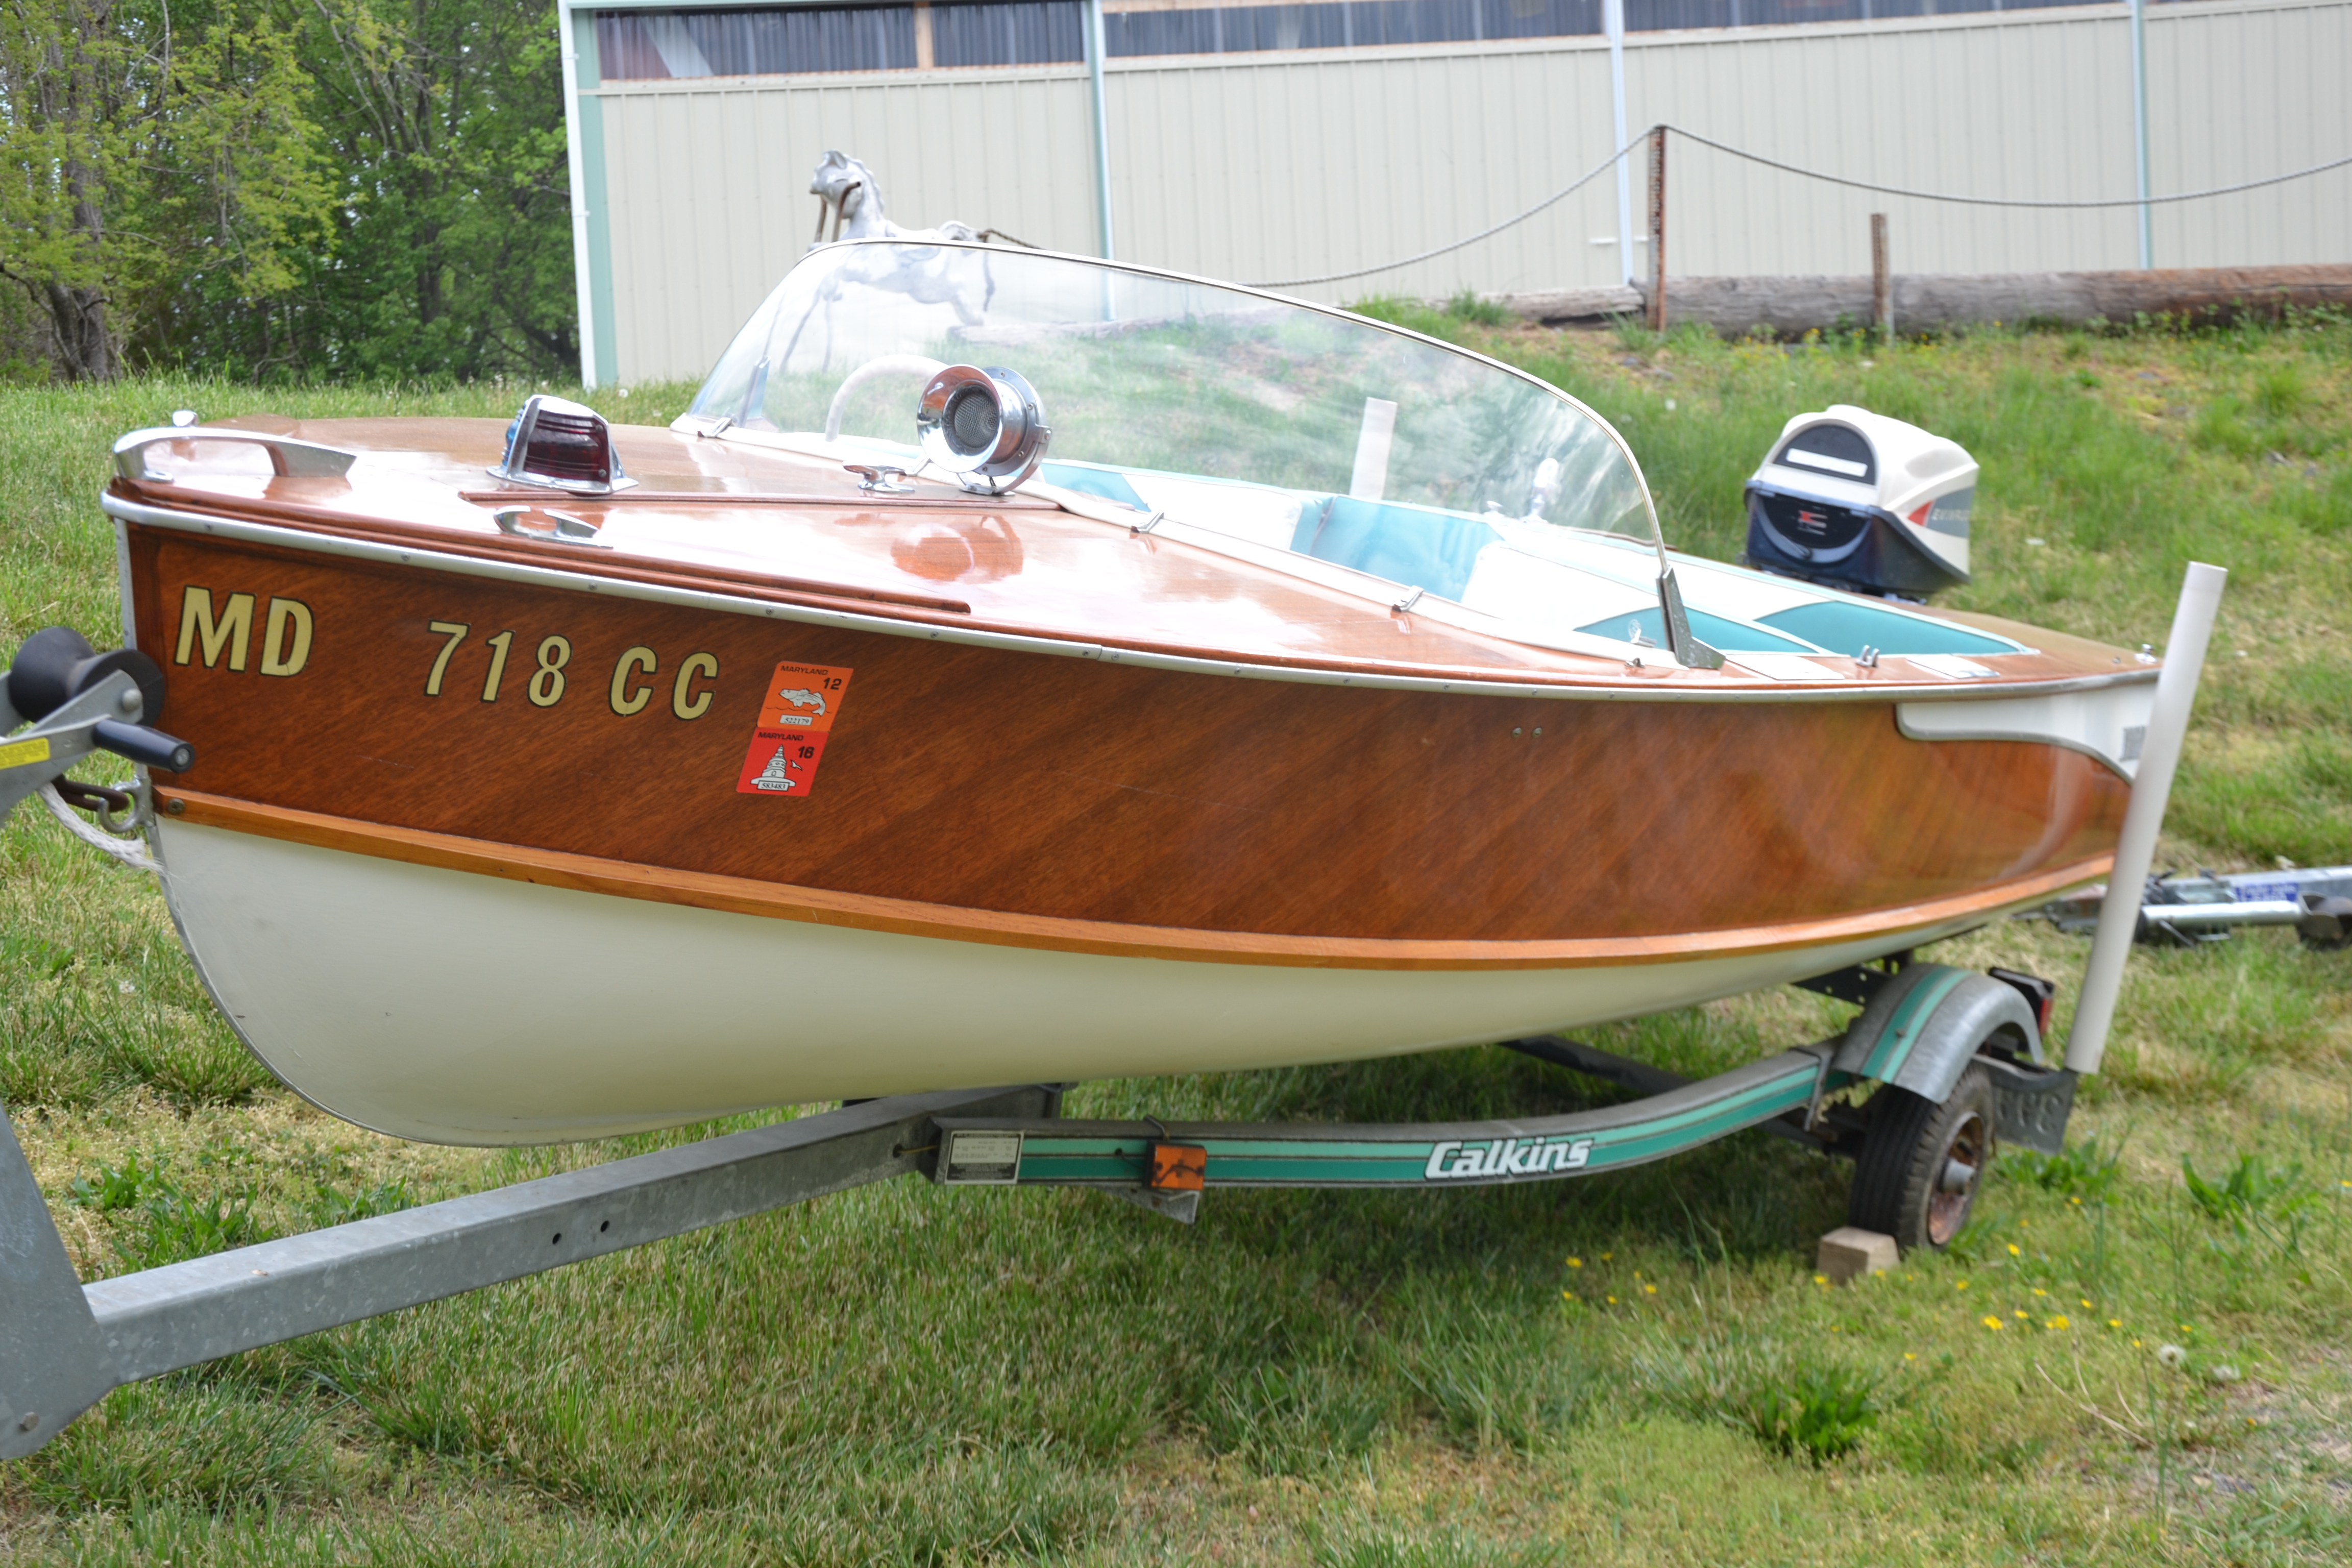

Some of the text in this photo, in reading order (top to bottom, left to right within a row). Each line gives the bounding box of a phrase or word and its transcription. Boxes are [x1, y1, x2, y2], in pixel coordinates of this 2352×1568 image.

[174, 585, 719, 720] MD 718 CC
[780, 666, 828, 675] MARYLAND
[823, 677, 842, 690] 12
[758, 732, 804, 741] MARYLAND
[798, 746, 815, 758] 16
[1424, 1136, 1594, 1179] Calkins
